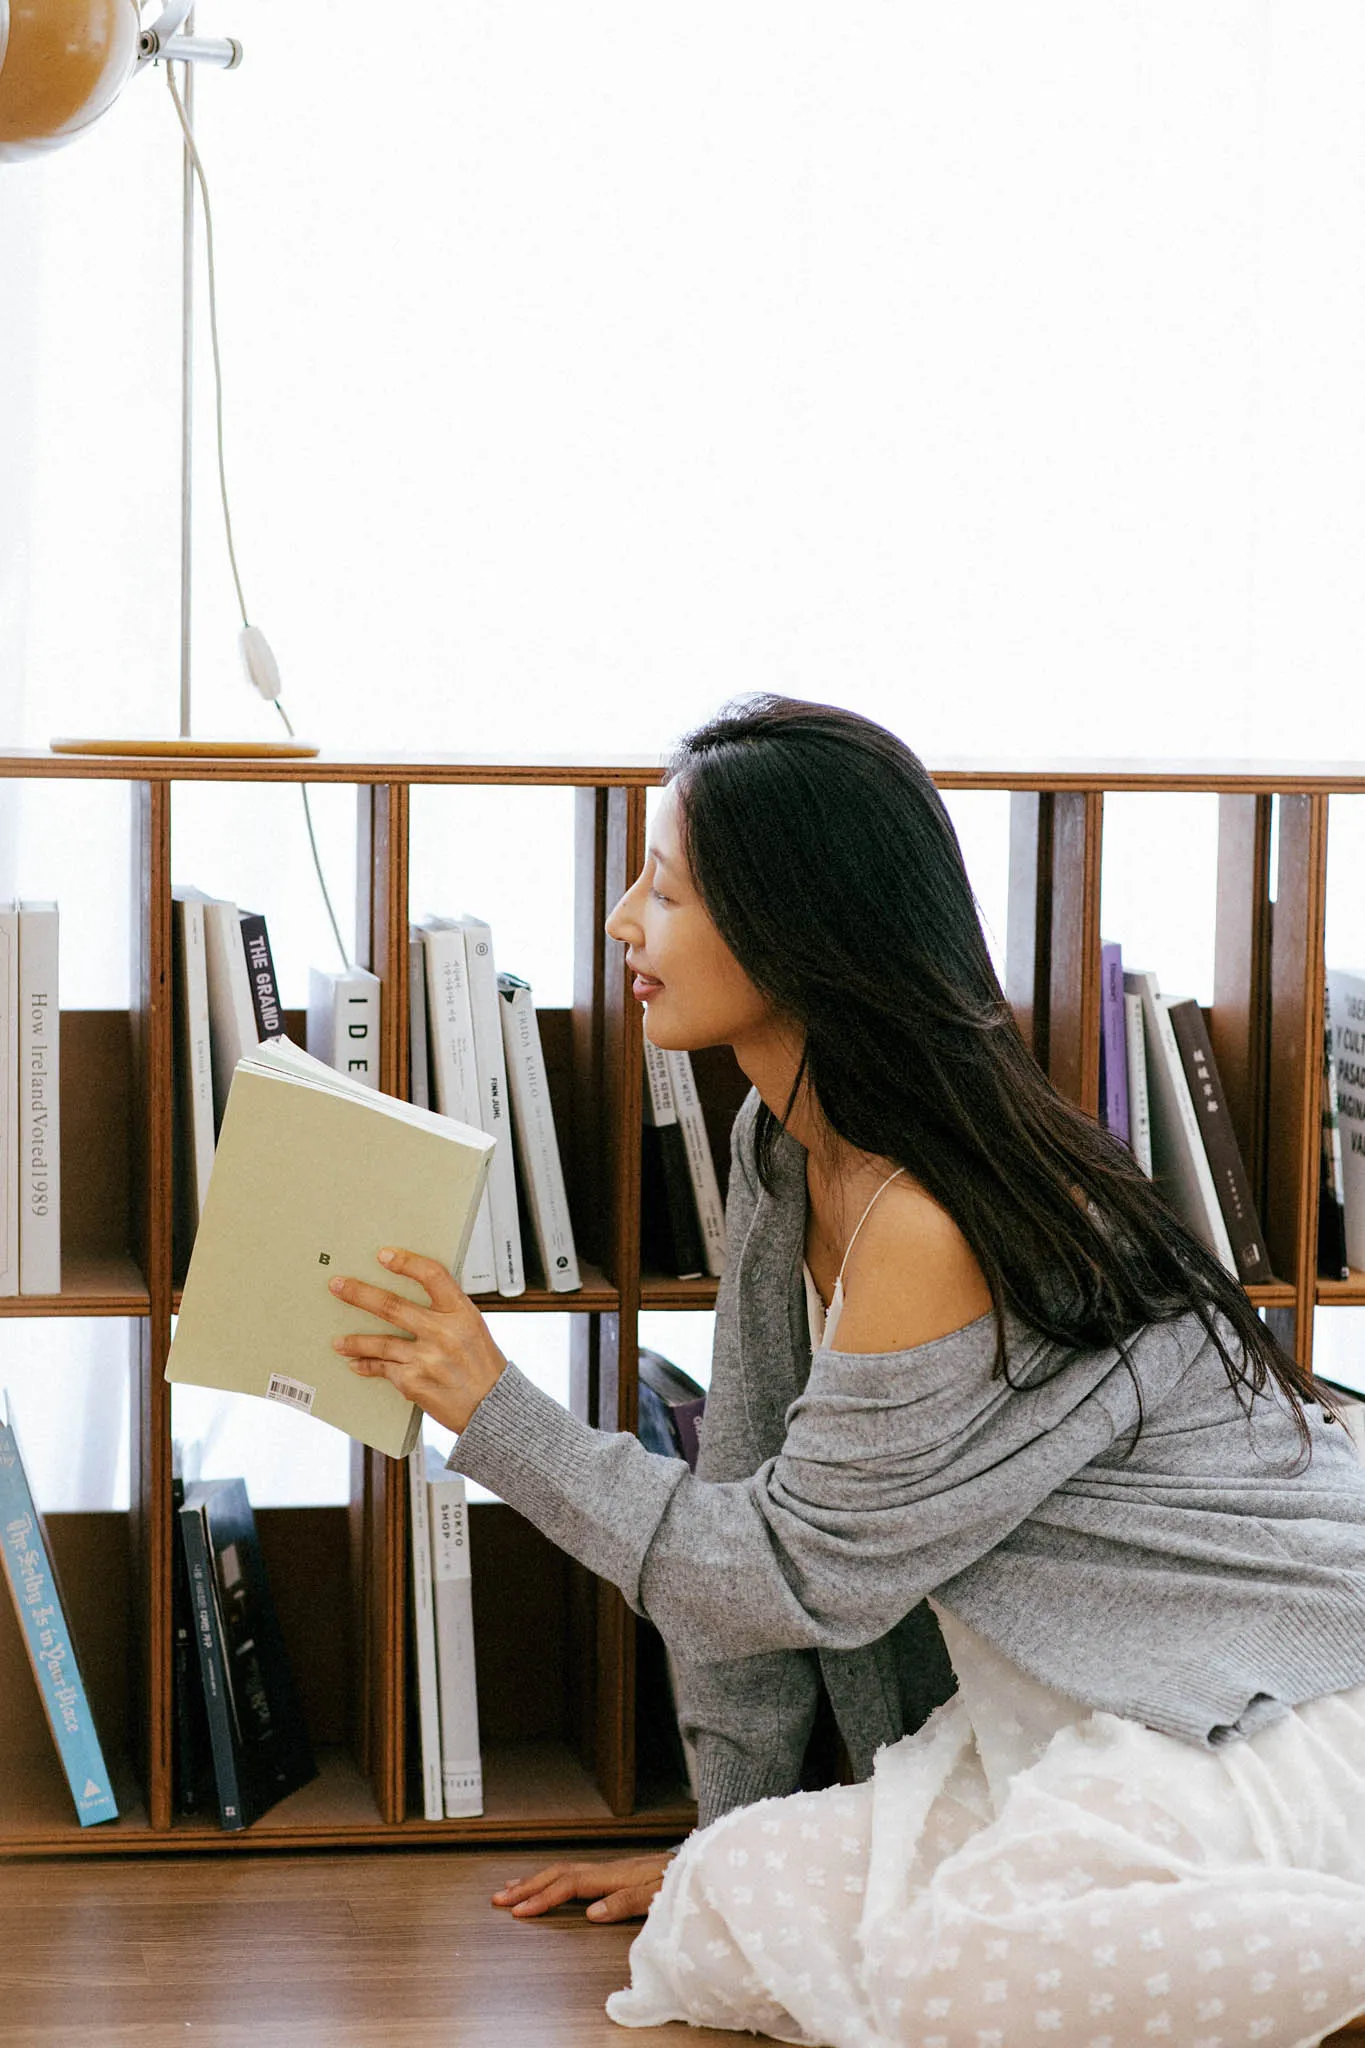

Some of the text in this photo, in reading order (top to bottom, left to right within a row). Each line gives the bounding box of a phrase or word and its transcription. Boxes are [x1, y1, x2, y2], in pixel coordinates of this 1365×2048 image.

[249, 935, 269, 969] THE
[30, 993, 48, 1037] How
[256, 972, 279, 1031] GRAND
[490, 1077, 501, 1119] FINN JUHL
[318, 1252, 331, 1266] B
[441, 1504, 450, 1539] SHOP
[454, 1503, 463, 1546] TOKYO
